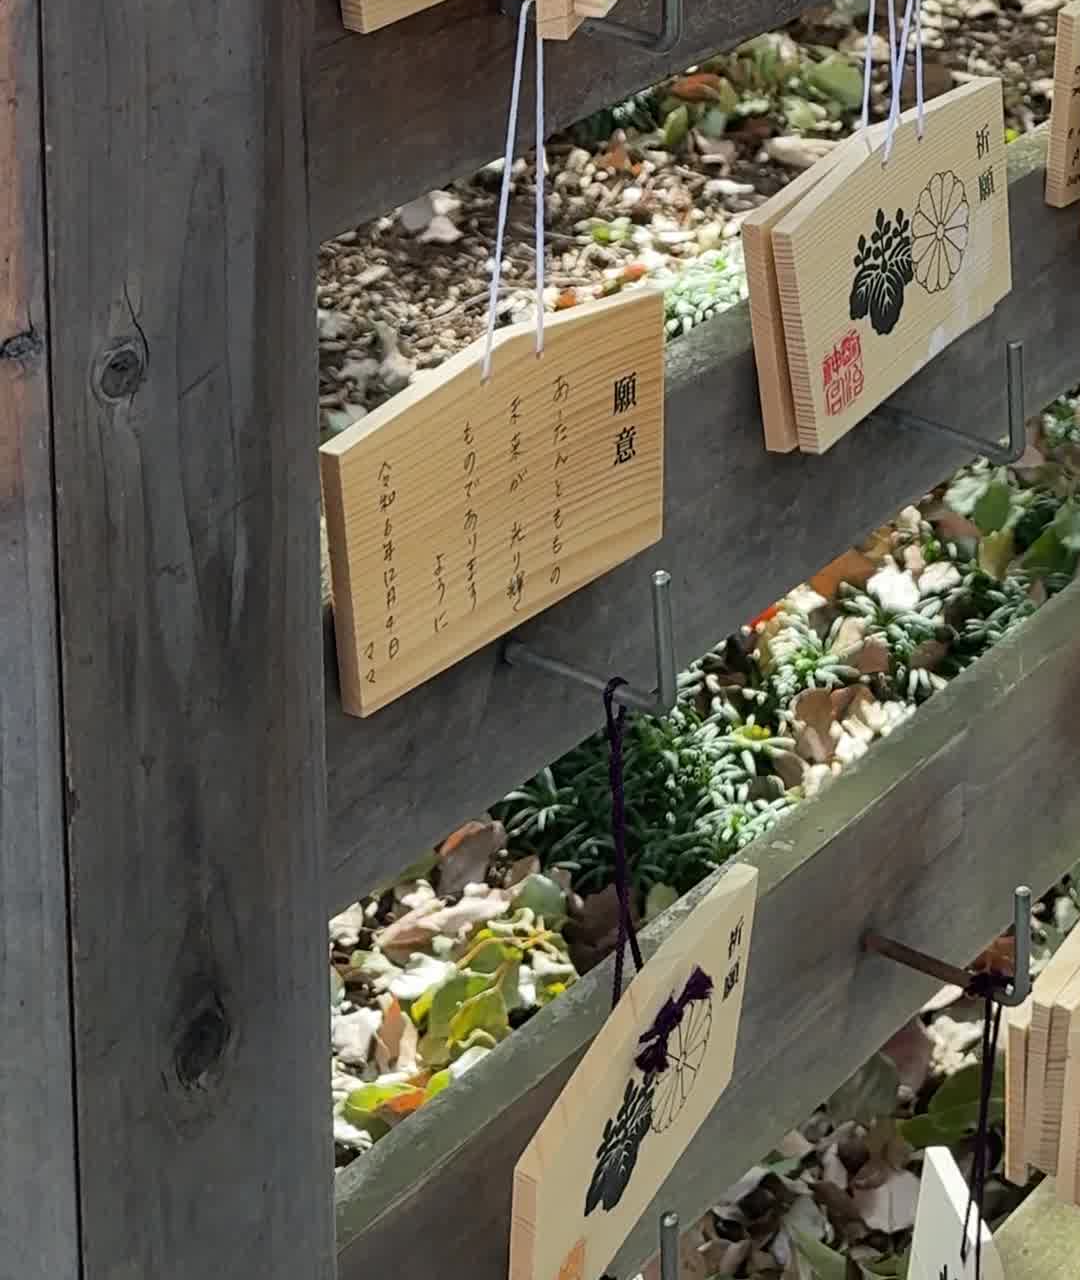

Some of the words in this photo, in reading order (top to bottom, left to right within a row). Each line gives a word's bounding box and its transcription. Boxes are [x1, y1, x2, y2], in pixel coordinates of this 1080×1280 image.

[975, 123, 995, 202] 祈願
[612, 371, 638, 467] 願意
[722, 913, 746, 1003] 祈願
